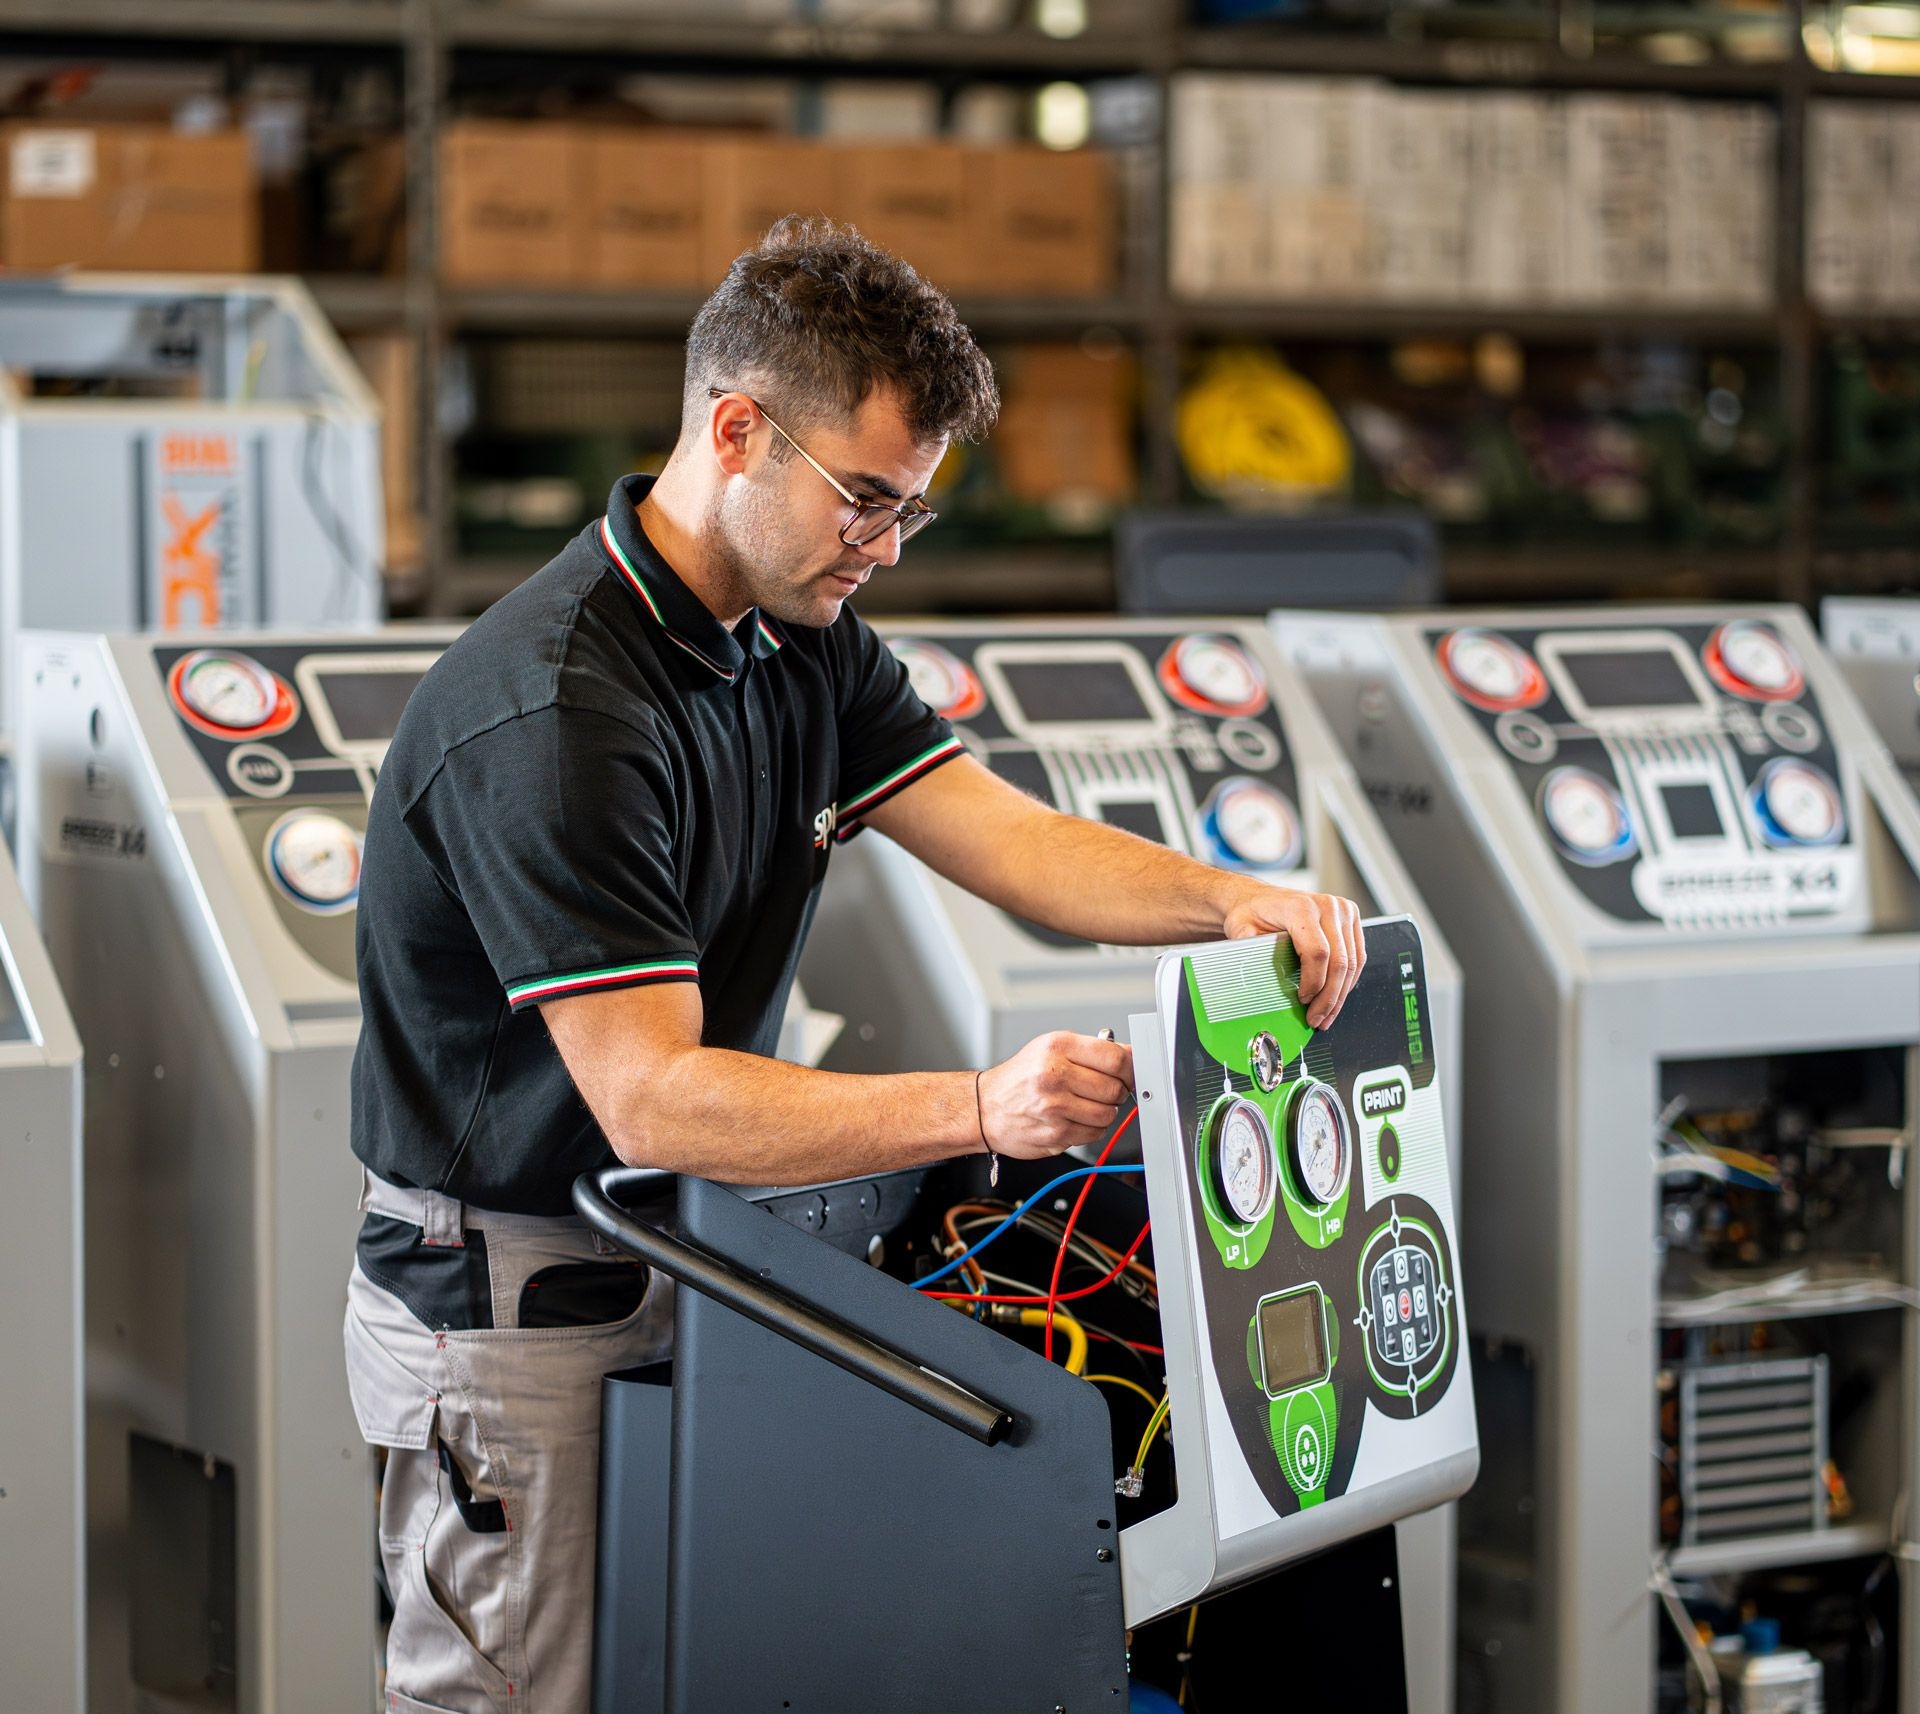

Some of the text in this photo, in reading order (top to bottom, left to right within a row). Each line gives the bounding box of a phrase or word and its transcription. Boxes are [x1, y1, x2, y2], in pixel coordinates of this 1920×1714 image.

[1364, 1085, 1402, 1112] PRINT
[1326, 1218, 1341, 1235] HP
[1226, 1244, 1240, 1262] LP
